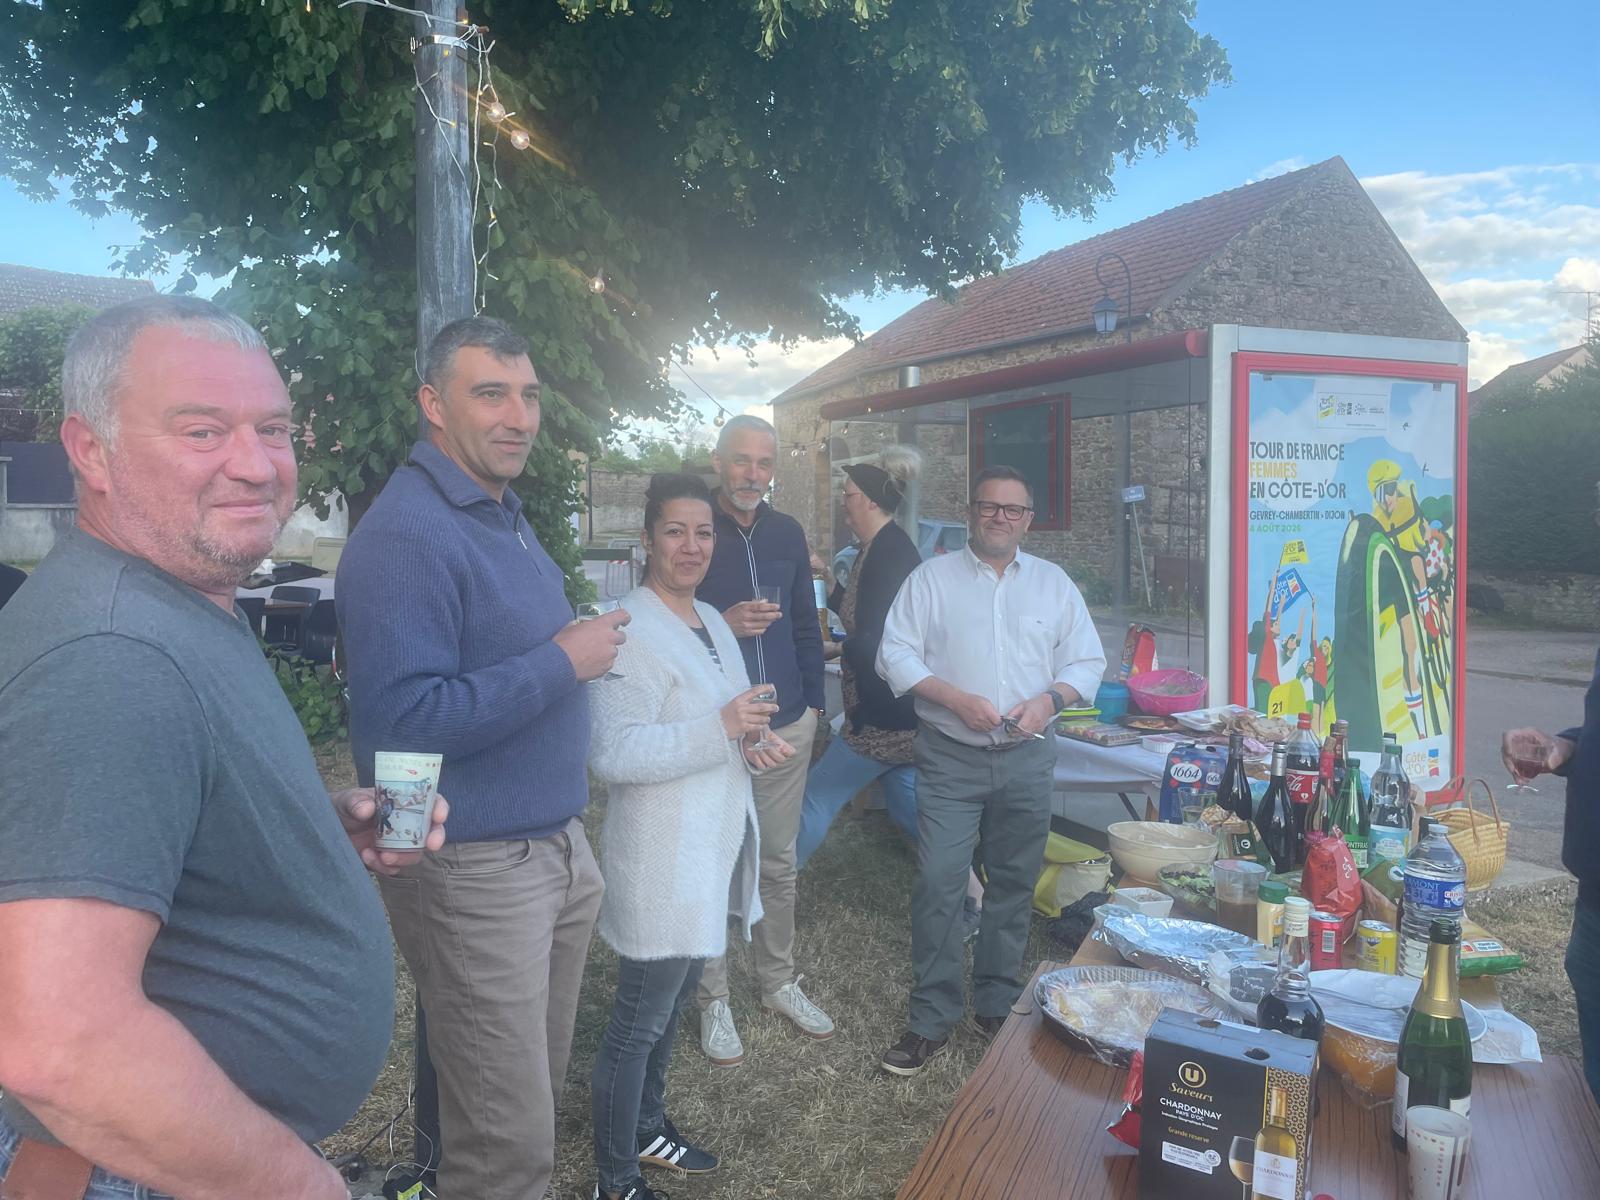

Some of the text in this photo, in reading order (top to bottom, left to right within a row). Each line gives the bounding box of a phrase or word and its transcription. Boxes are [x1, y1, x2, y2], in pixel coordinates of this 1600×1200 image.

[1249, 441, 1345, 461] TOUR DE FRANCE
[1249, 462, 1297, 478] FEMMES
[1250, 477, 1346, 499] EN CÔTE-D'OR
[1249, 510, 1345, 520] GEVREY-CHAMBERTIN DIJON
[1271, 700, 1283, 715] 21
[1172, 766, 1200, 780] 1664
[1184, 1067, 1200, 1083] U
[1168, 1082, 1214, 1103] Saveurs
[1159, 1097, 1222, 1121] CHARDONNAY
[1175, 1109, 1190, 1118] PAYS
[1190, 1113, 1206, 1122] D'OC
[1168, 1125, 1188, 1138] Grande
